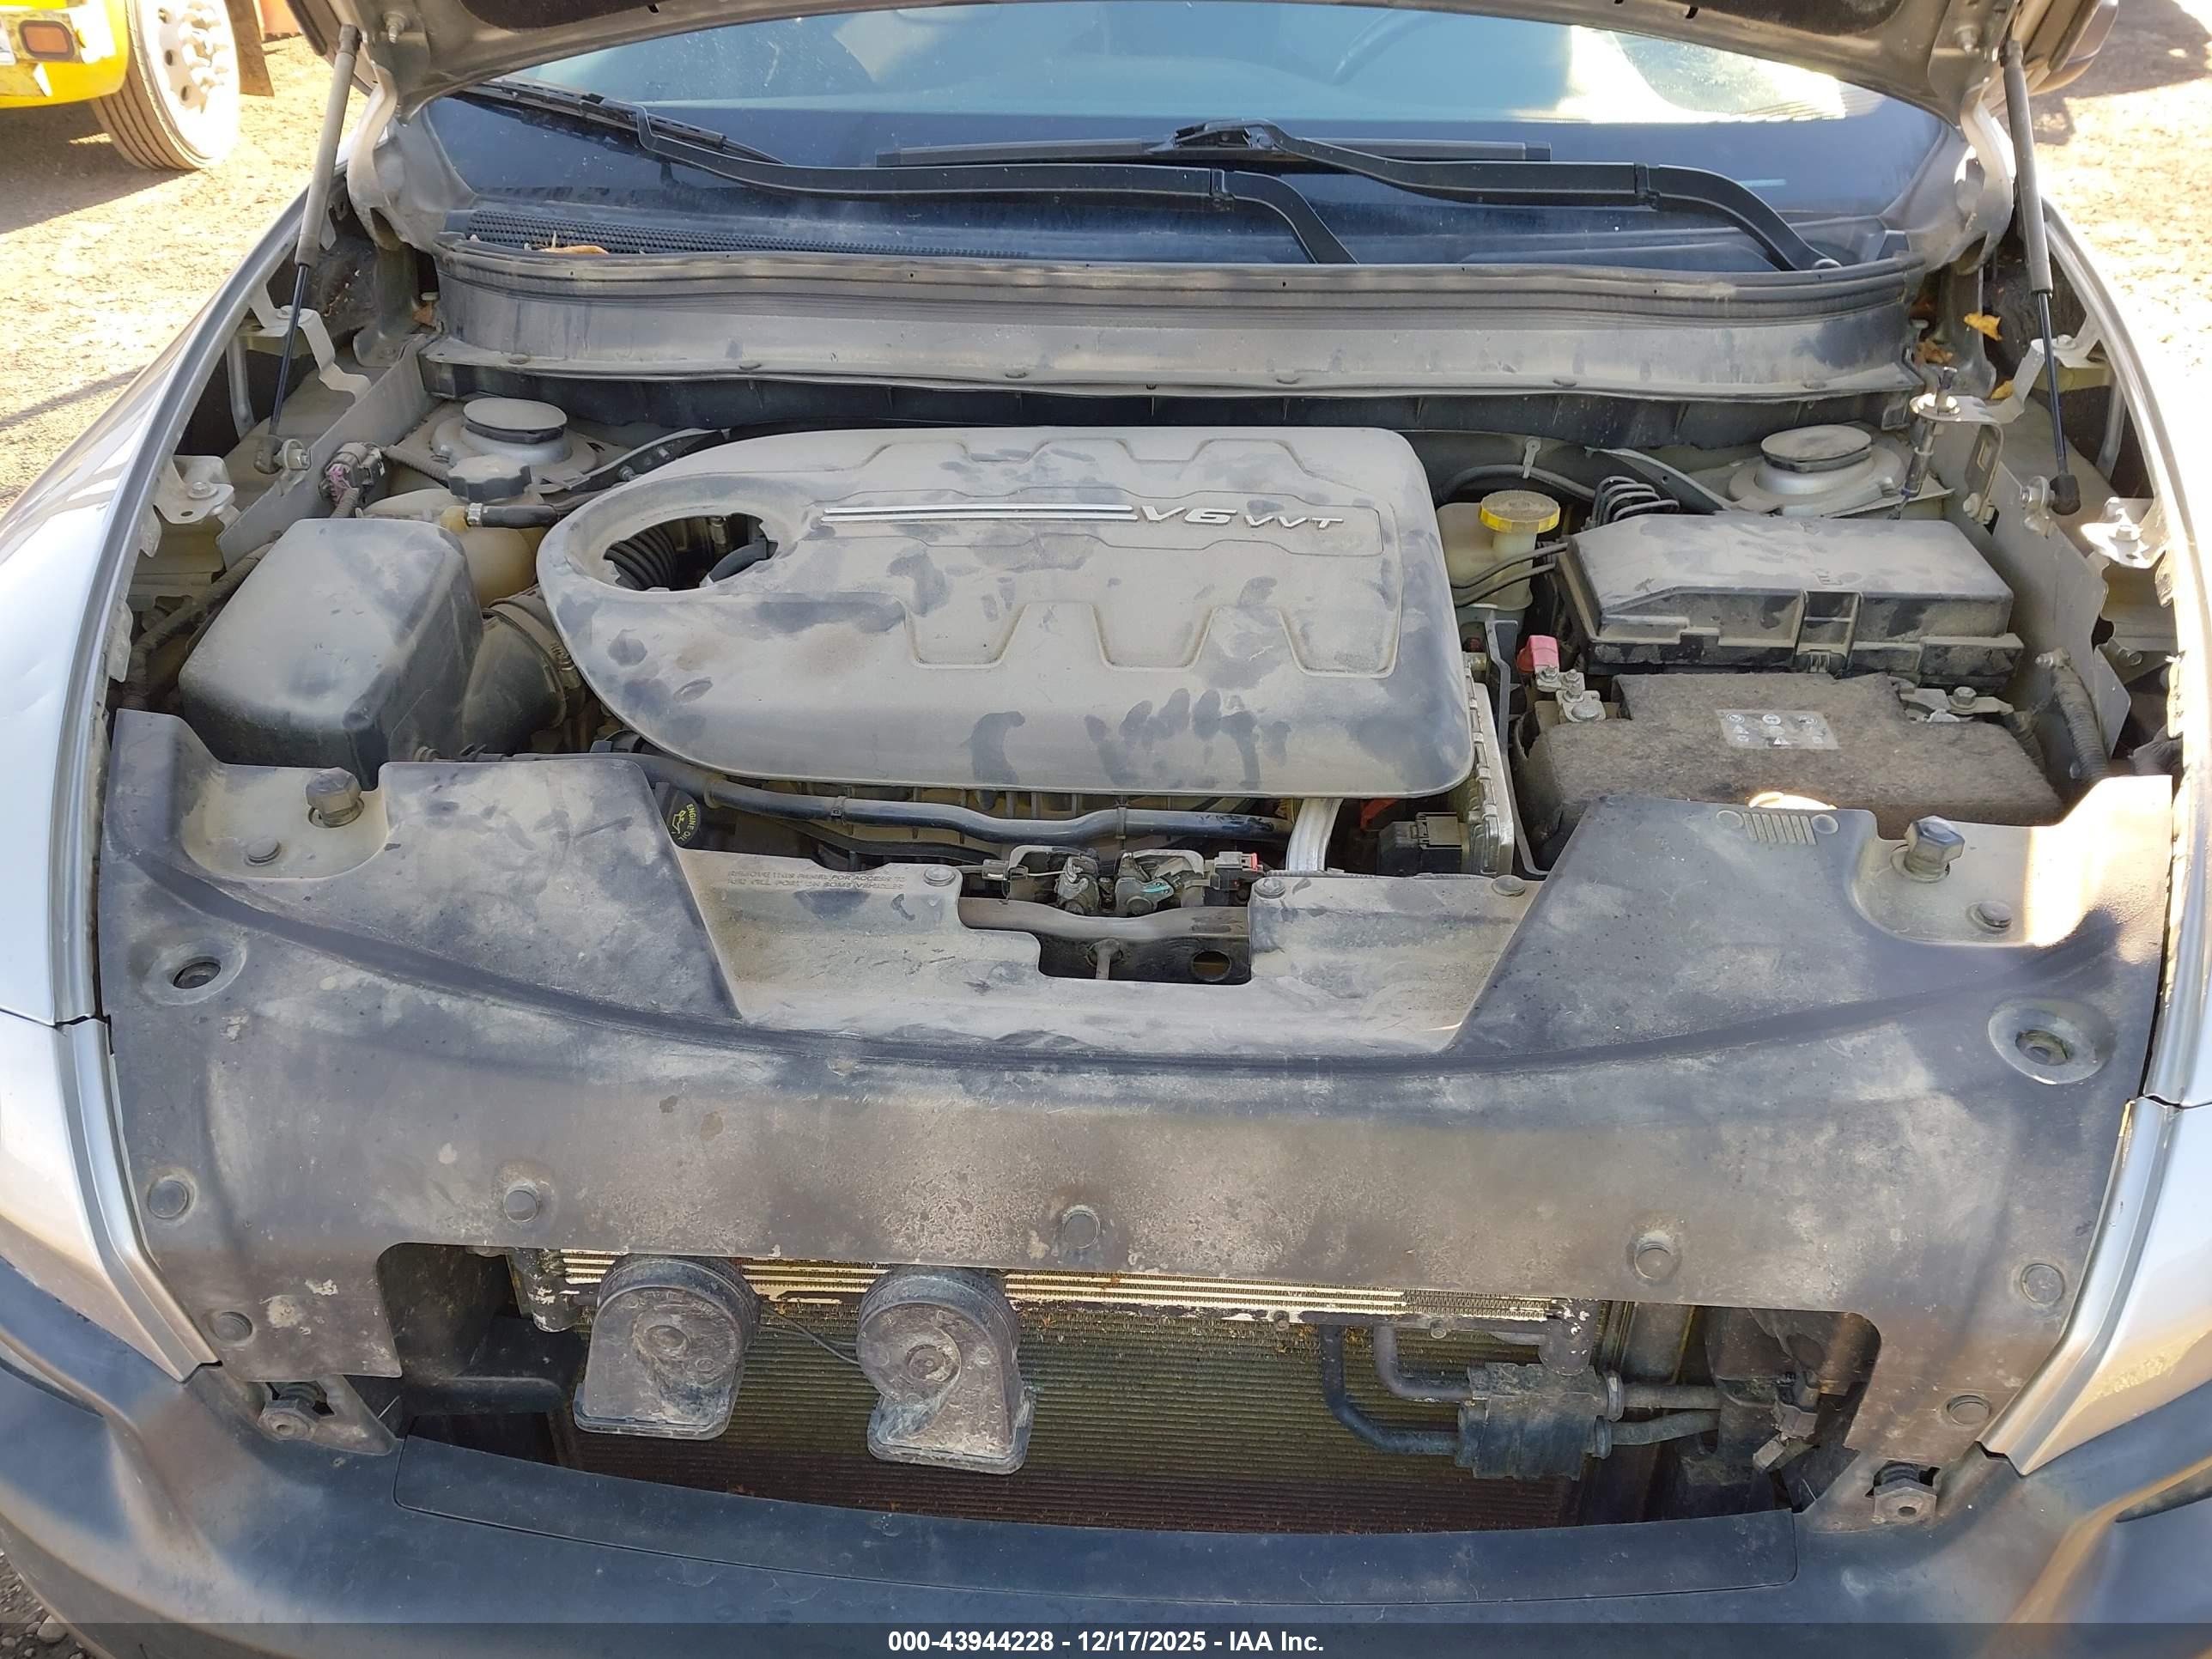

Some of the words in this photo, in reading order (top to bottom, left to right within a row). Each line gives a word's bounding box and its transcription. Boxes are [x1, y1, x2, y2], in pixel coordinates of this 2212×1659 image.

[1140, 505, 1237, 526] V6
[1244, 514, 1344, 530] VVT
[686, 803, 696, 830] ENGINE
[678, 830, 691, 842] OIL
